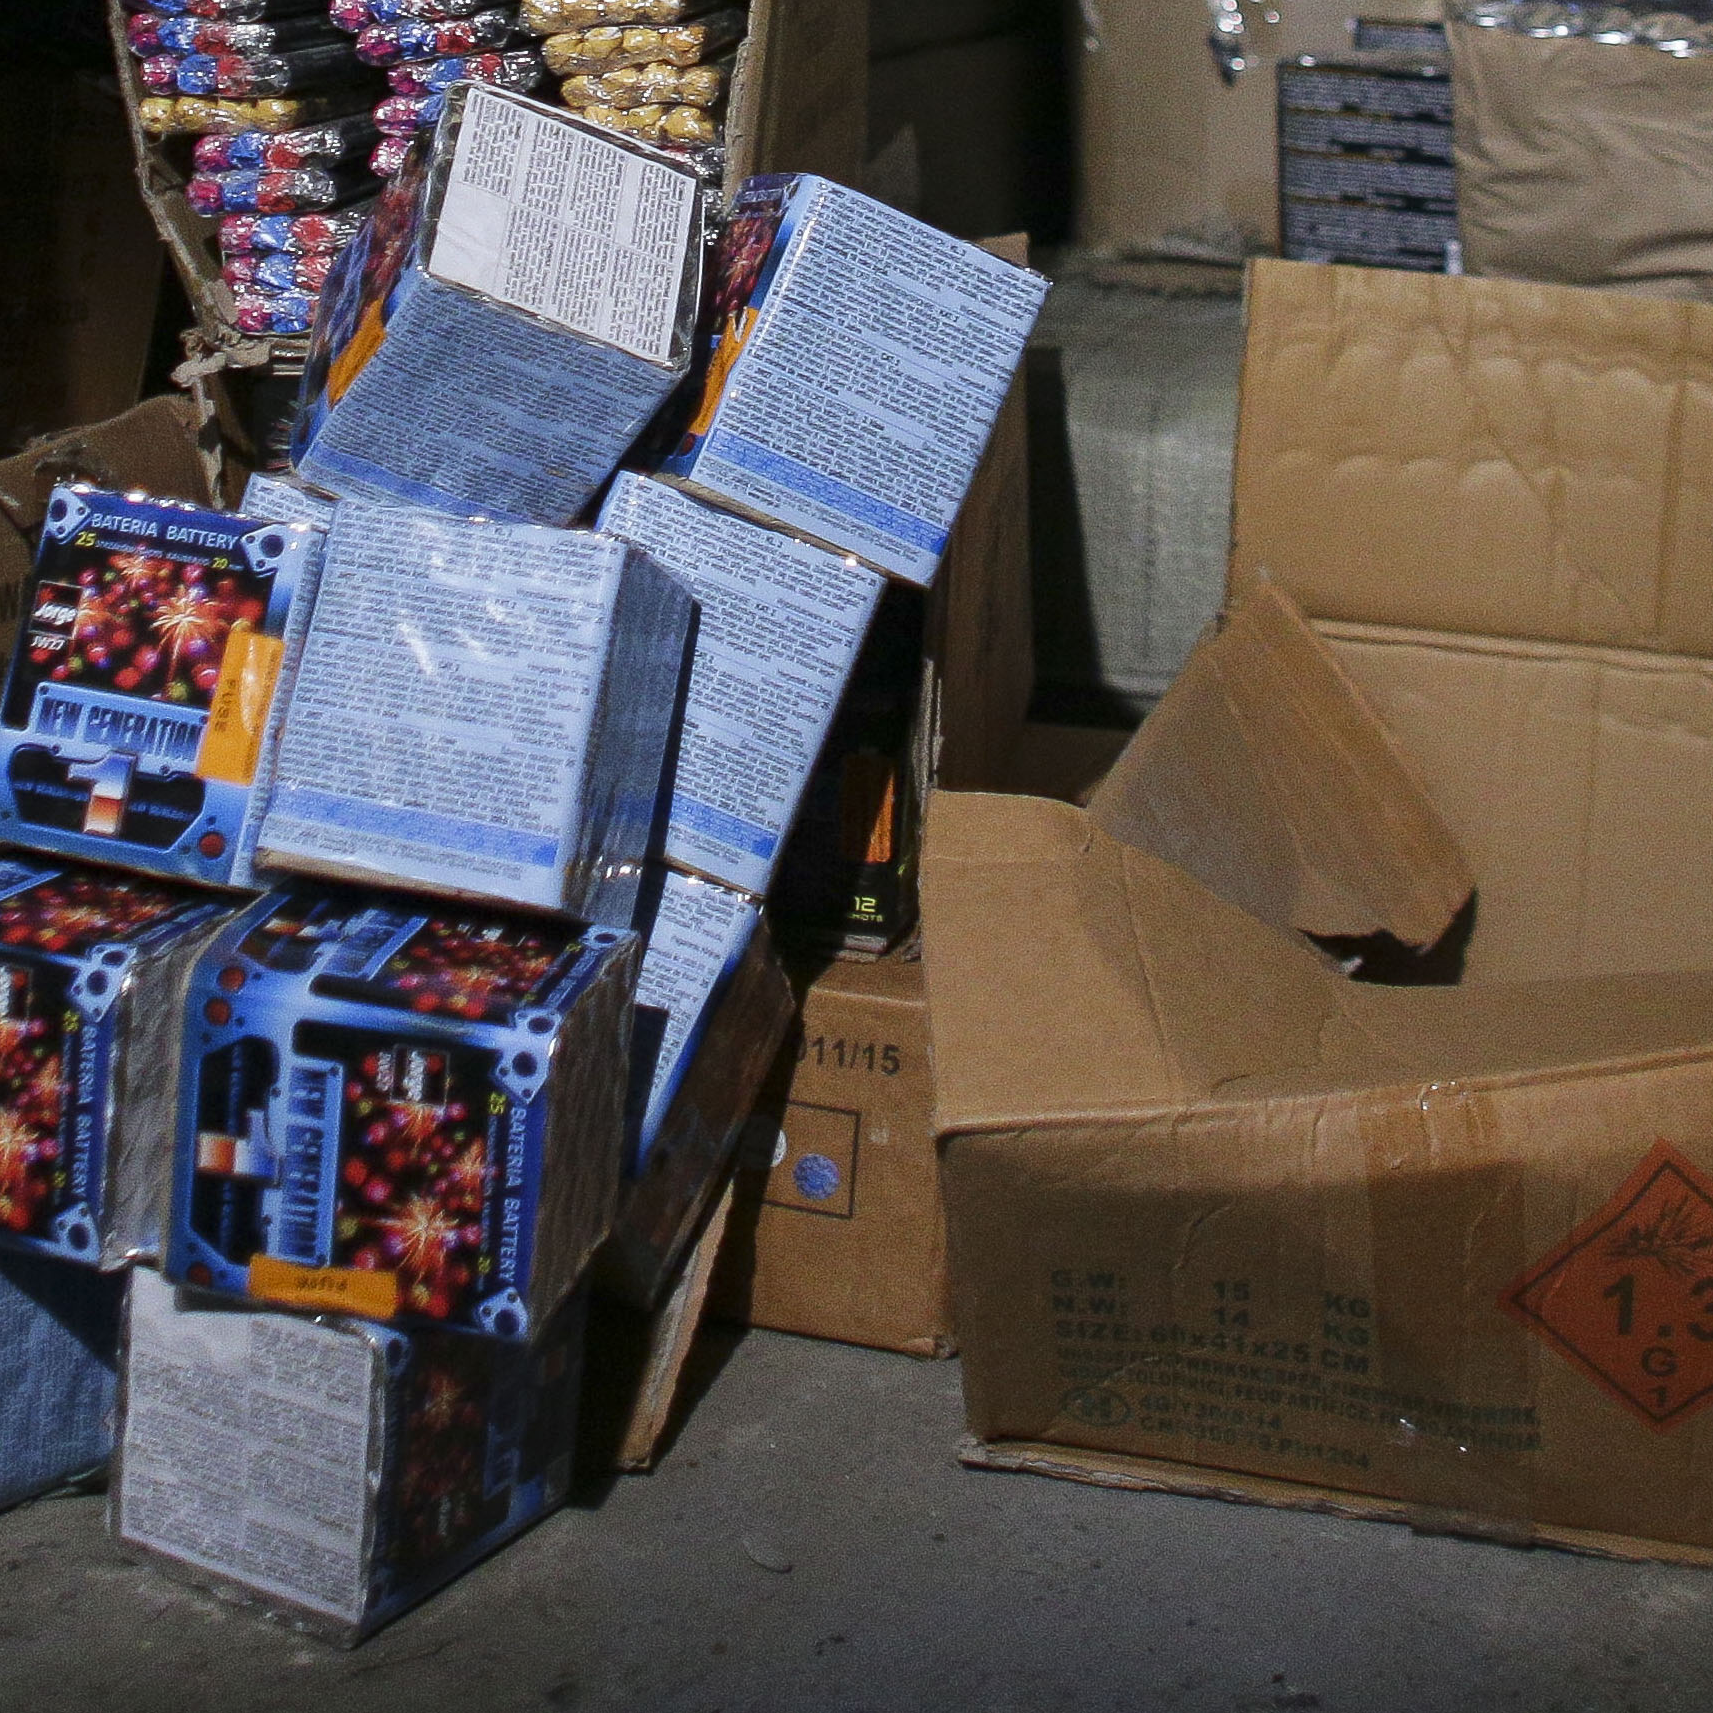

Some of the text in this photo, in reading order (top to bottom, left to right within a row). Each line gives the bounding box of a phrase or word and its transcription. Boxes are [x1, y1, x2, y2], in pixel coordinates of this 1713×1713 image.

[74, 531, 97, 547] 25
[91, 513, 238, 549] BATERIA BATTERY
[854, 896, 877, 913] 12
[498, 1106, 528, 1284] BATERIA BATTERY
[1641, 1346, 1680, 1377] G
